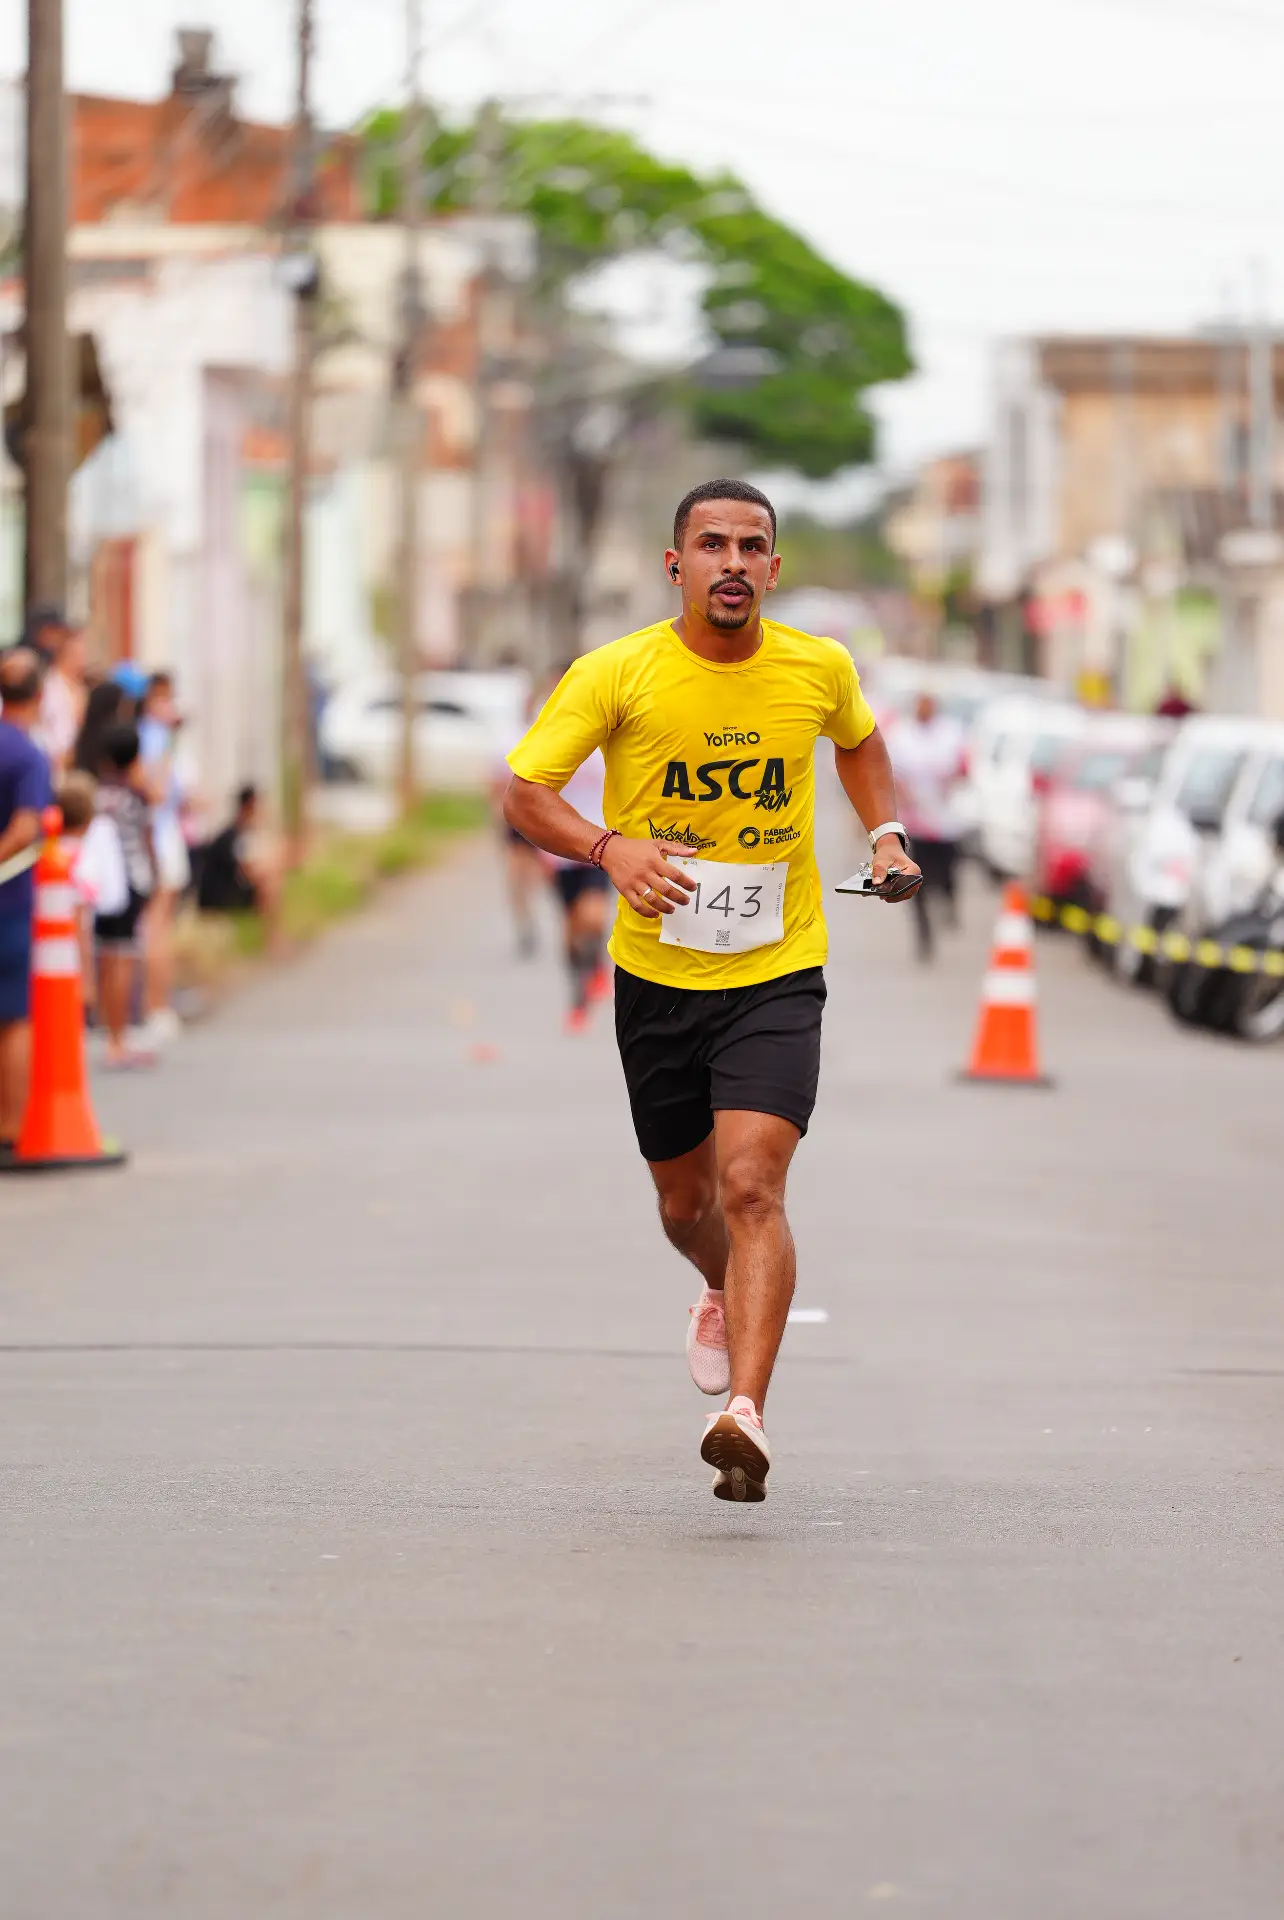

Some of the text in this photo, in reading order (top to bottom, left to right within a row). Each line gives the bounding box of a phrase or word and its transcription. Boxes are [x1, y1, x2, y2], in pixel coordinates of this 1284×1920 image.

[661, 757, 785, 802] ASCA
[752, 787, 793, 813] RUN
[763, 837, 774, 845] DE
[694, 882, 763, 918] 143
